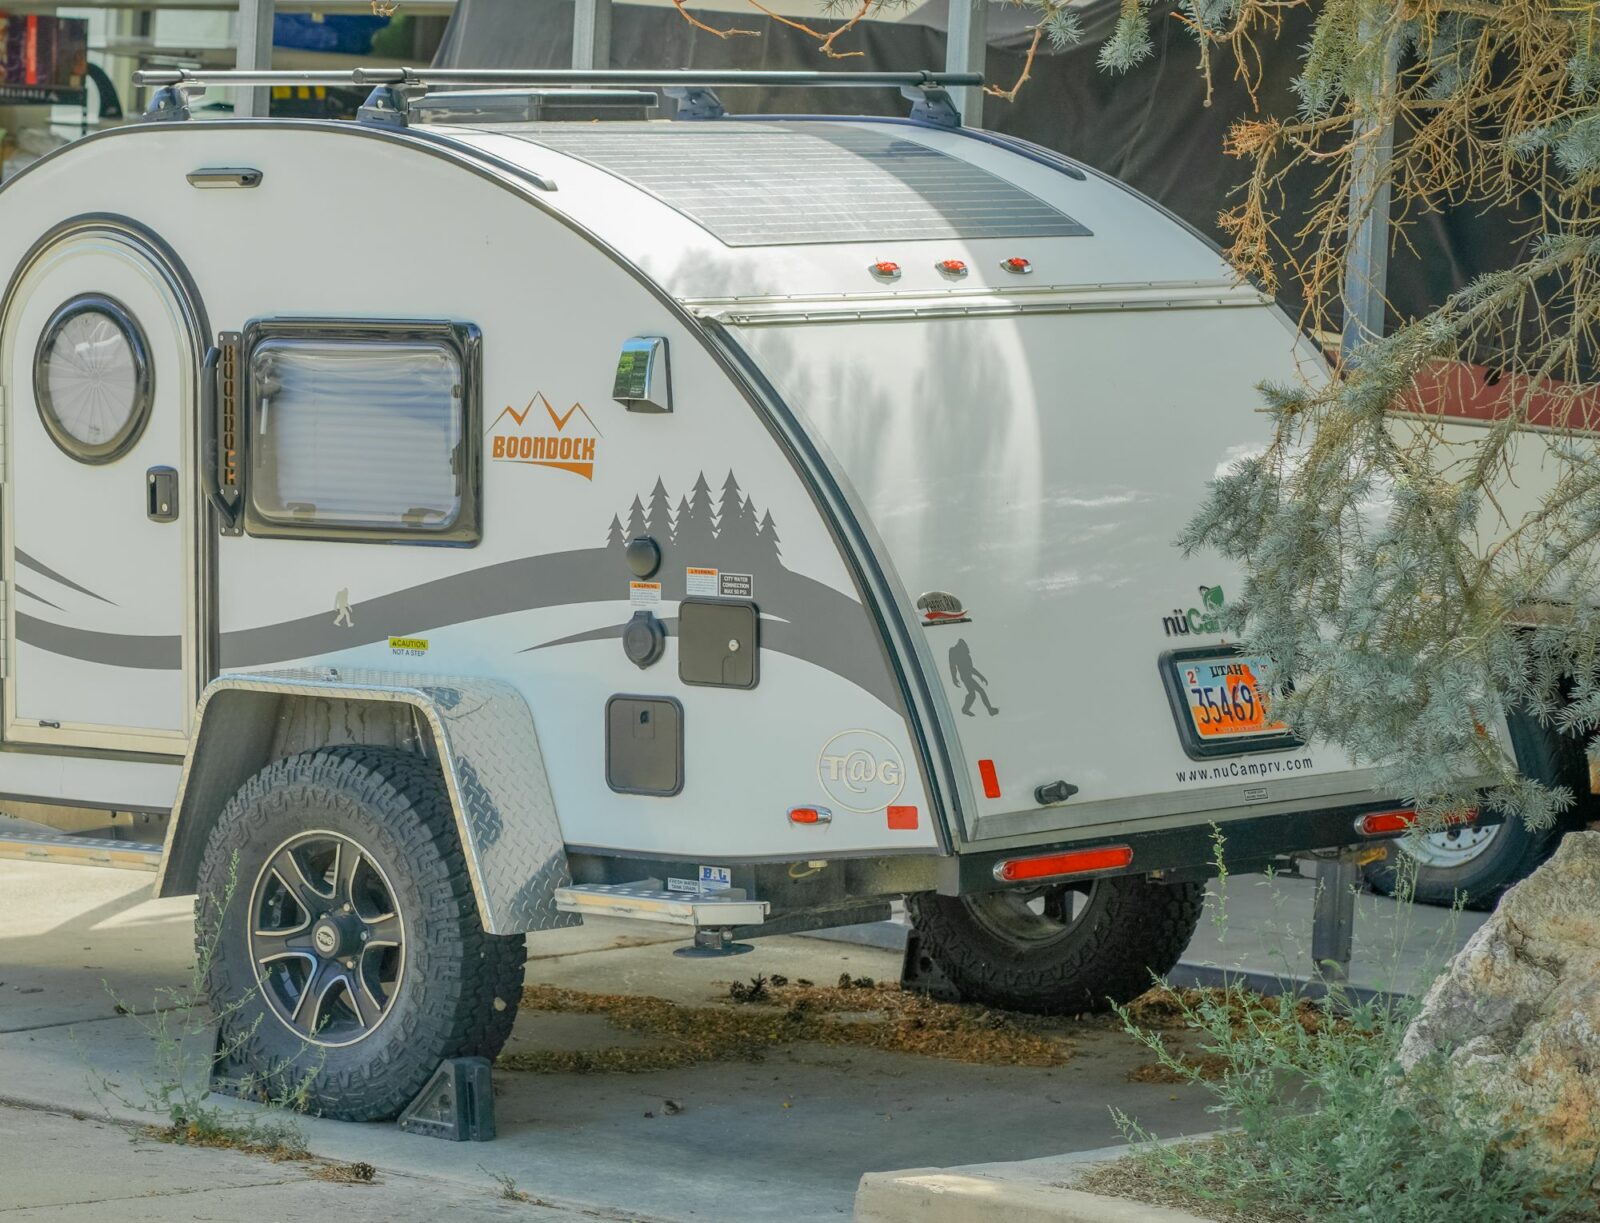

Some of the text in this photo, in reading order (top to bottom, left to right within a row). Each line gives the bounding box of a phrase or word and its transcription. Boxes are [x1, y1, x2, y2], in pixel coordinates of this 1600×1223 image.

[223, 345, 236, 486] BOONDOCK
[492, 435, 596, 461] BOONDOCK
[392, 648, 404, 656] NOT
[396, 639, 426, 648] CAUTION
[1187, 671, 1196, 684] 2
[1209, 664, 1243, 678] UTAH
[823, 750, 900, 793] T@G
[1175, 757, 1313, 783] www.nuCamprv.com
